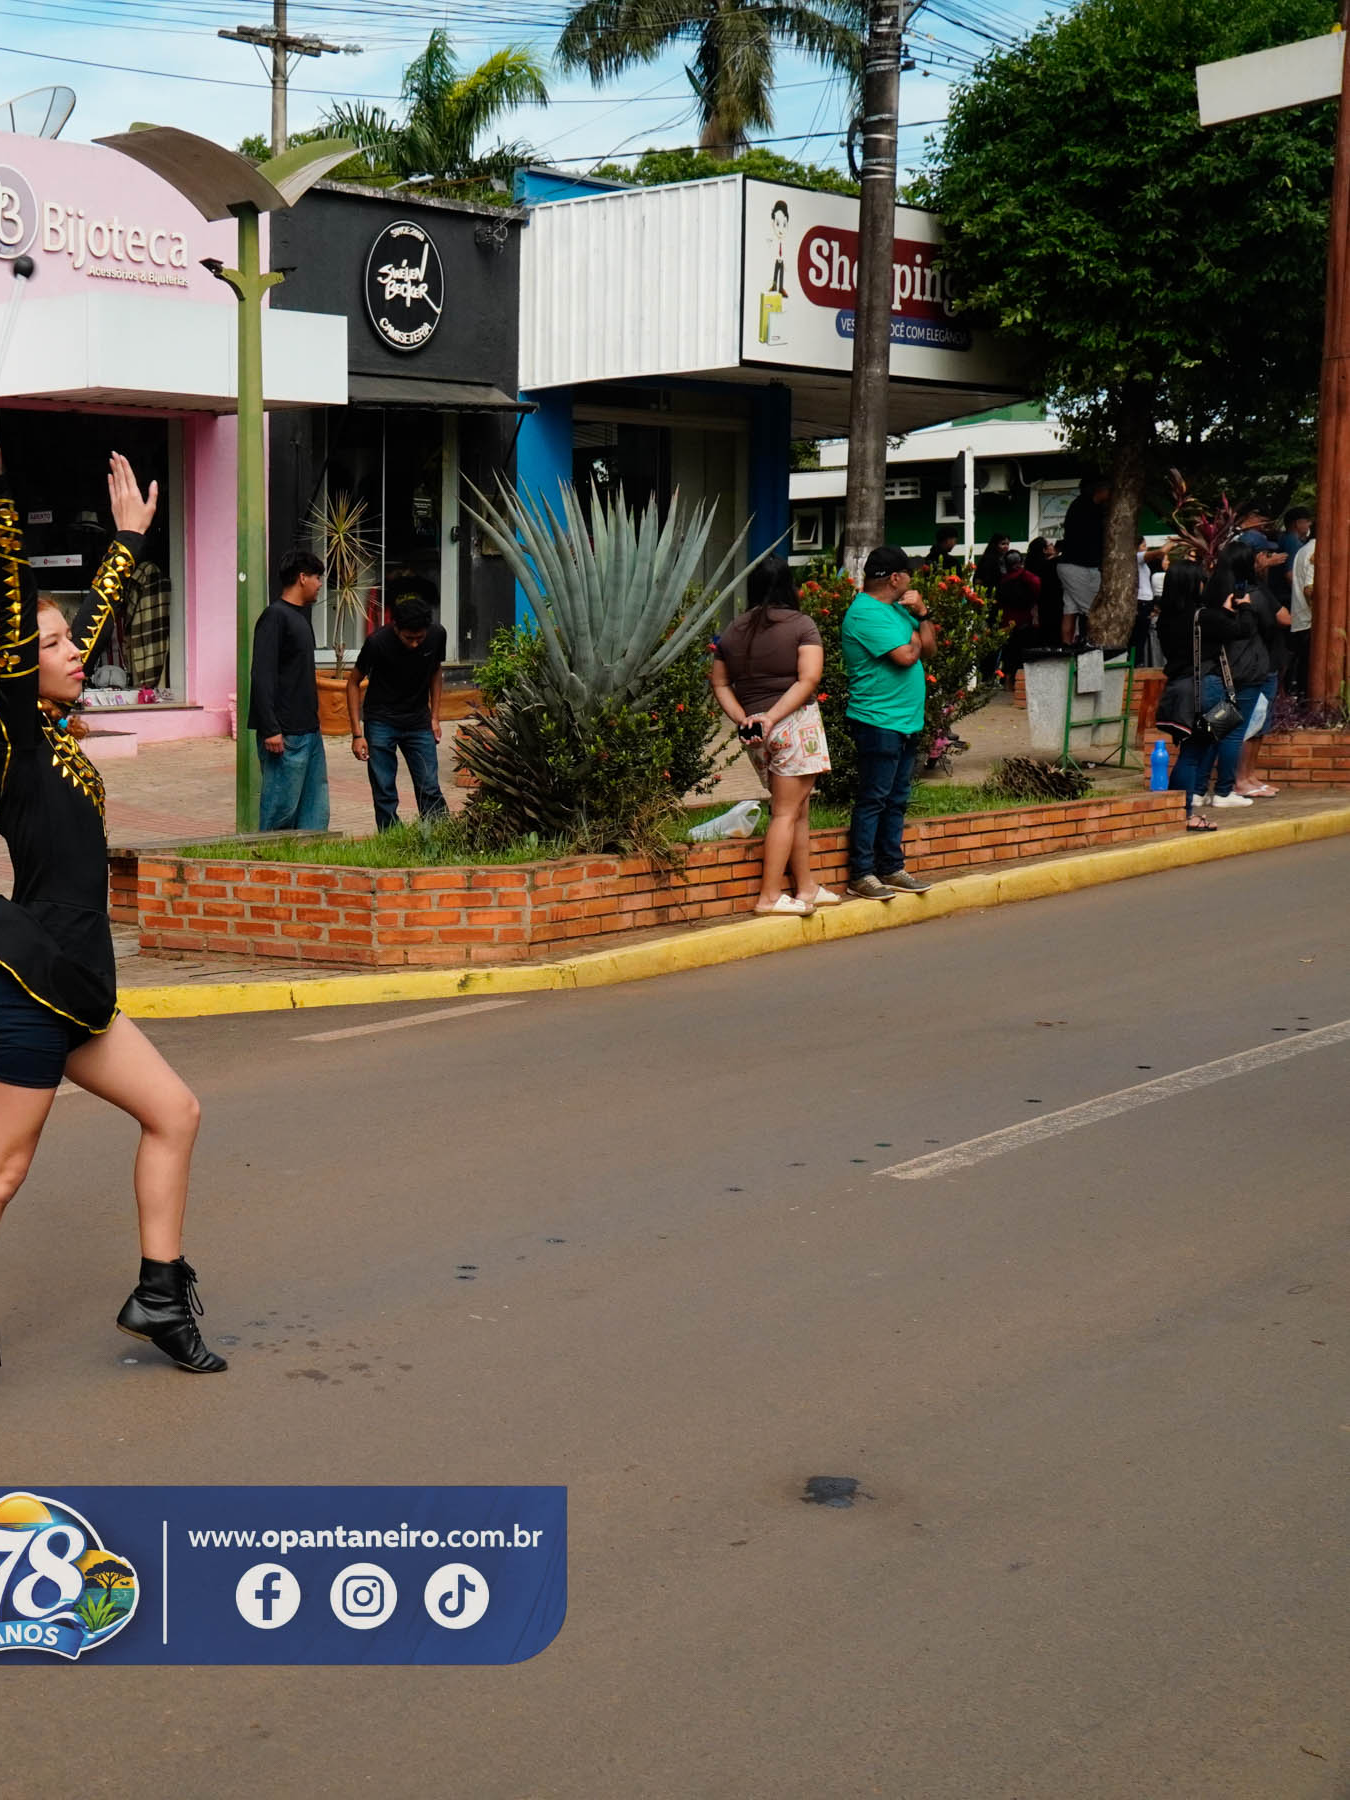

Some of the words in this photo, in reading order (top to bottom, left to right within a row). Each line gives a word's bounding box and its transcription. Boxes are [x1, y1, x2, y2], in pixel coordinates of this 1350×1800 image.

[42, 199, 188, 270] Bijoteca
[808, 237, 959, 318] Shping
[379, 317, 433, 344] CAMISETERIA
[890, 321, 905, 338] OCÊ
[906, 325, 925, 341] COM
